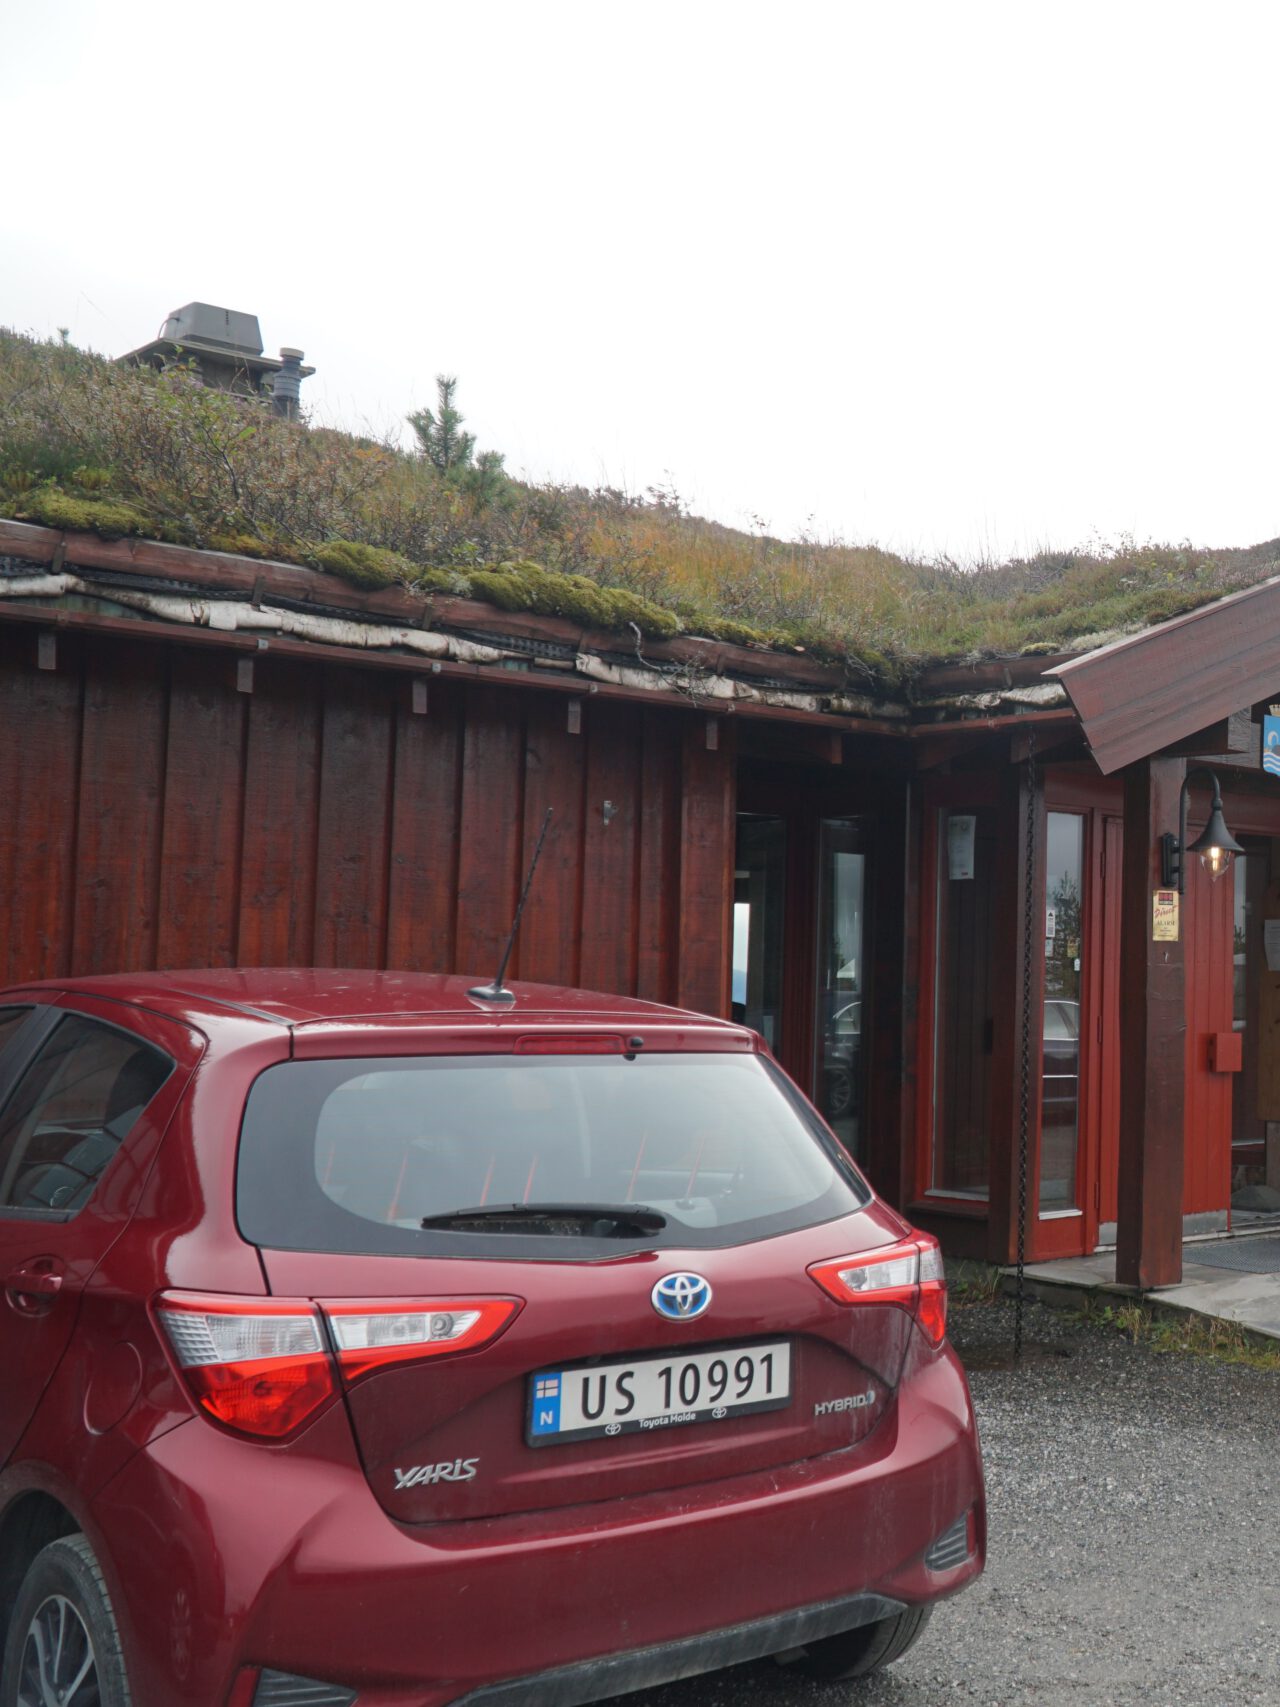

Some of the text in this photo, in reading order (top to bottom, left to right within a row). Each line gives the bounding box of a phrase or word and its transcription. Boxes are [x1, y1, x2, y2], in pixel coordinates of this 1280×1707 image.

[581, 1353, 773, 1420] US 10991
[814, 1394, 866, 1416] HYBRID
[540, 1410, 553, 1425] N
[638, 1411, 696, 1429] Toyota Molde
